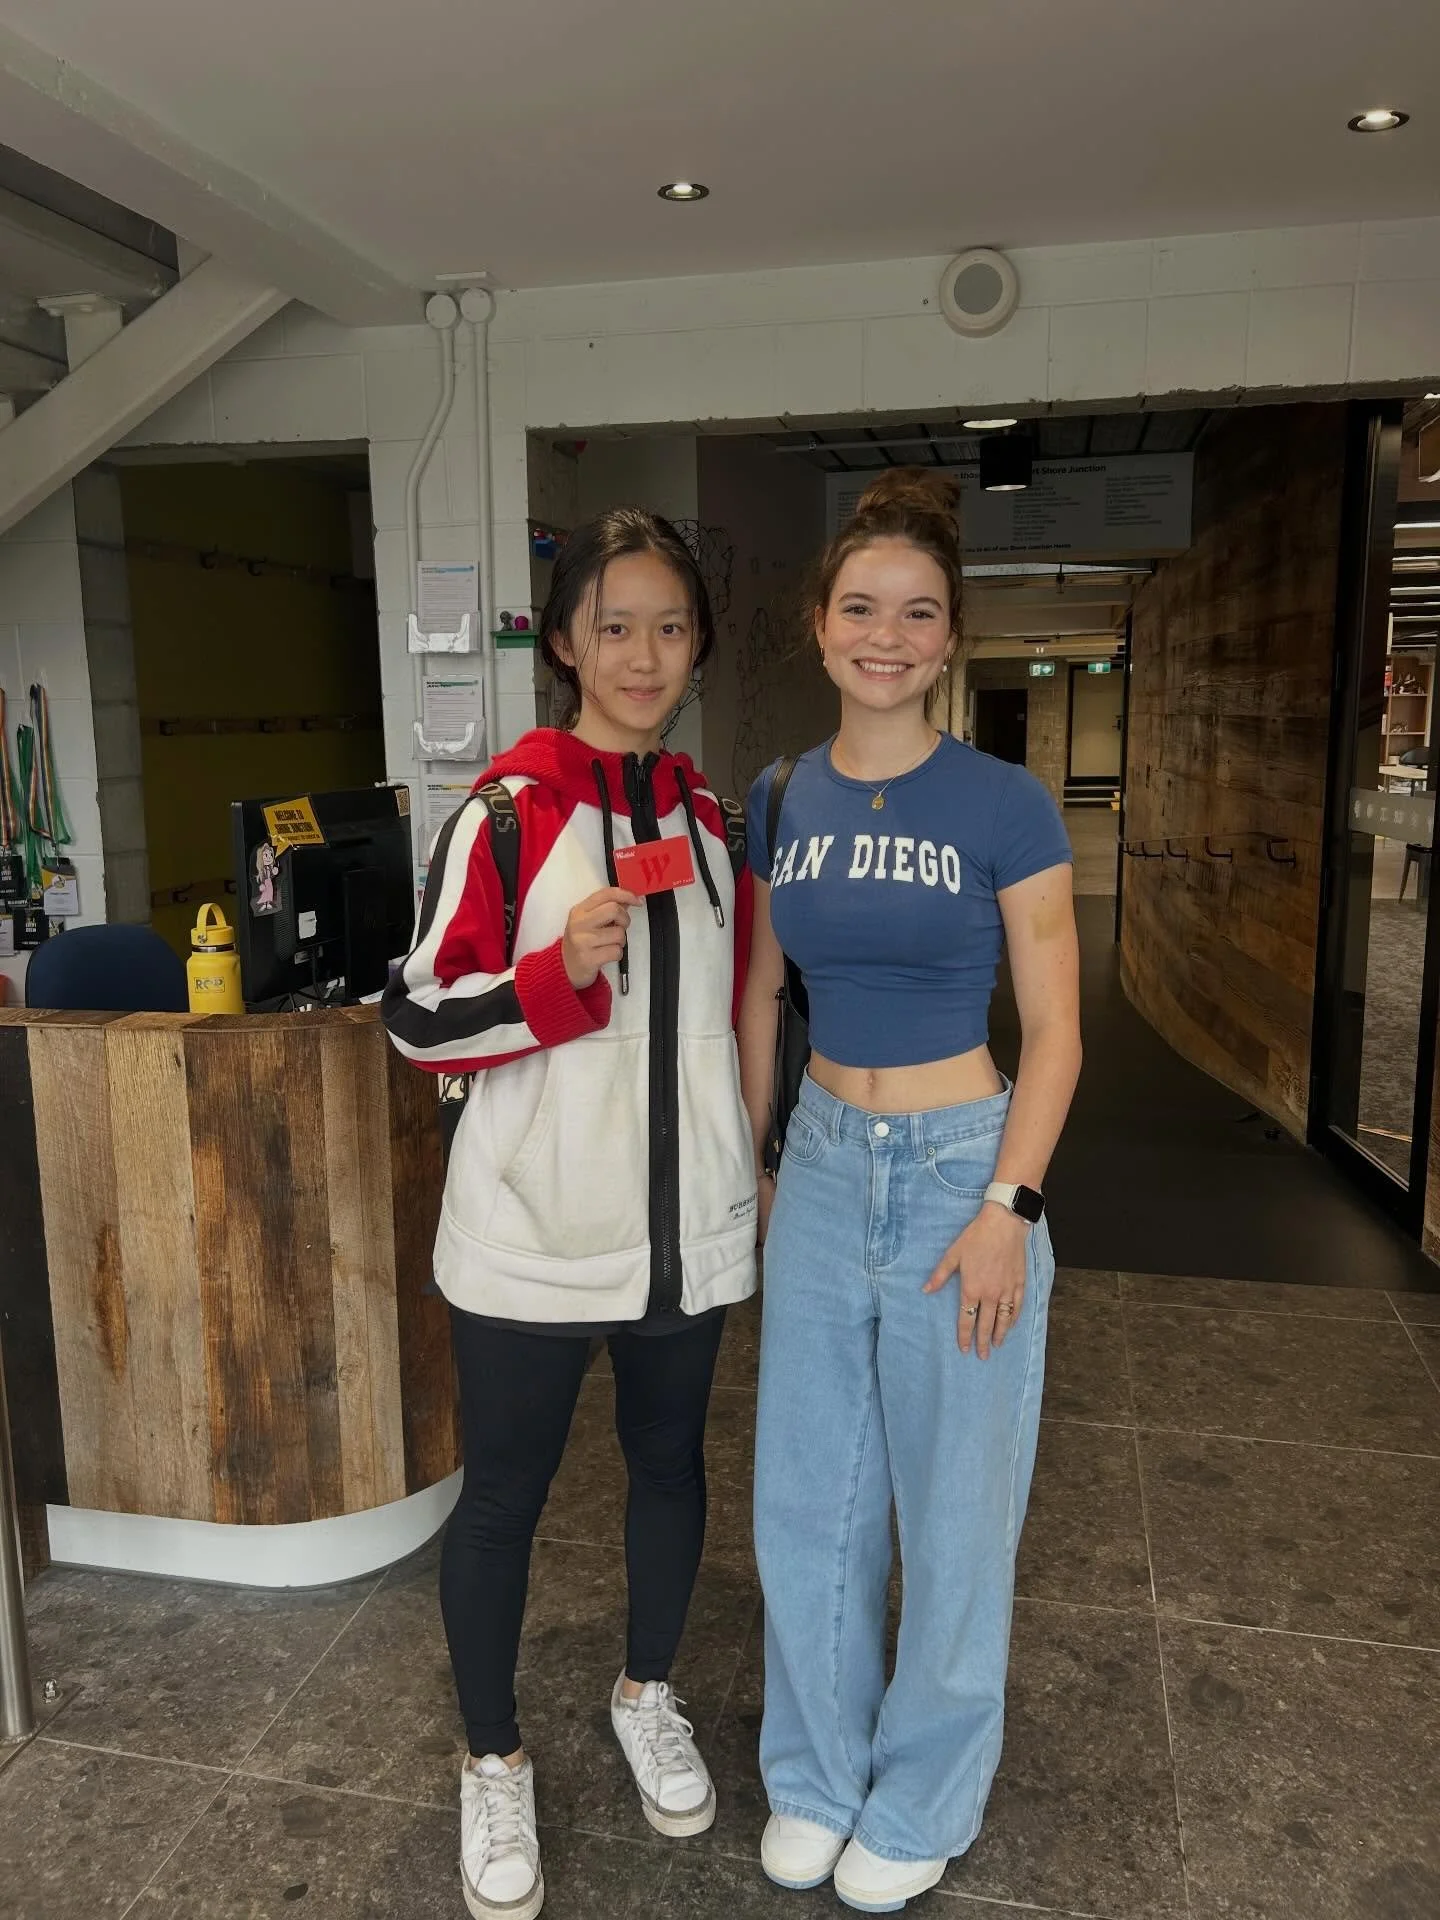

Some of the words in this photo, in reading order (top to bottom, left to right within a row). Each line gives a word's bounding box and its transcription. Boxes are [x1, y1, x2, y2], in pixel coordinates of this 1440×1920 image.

[1041, 467, 1067, 475] Shore
[1068, 464, 1106, 474] Junction
[478, 782, 517, 833] OUS
[721, 798, 745, 852] OUS
[770, 834, 835, 892] SAN
[848, 834, 961, 895] DIEGO
